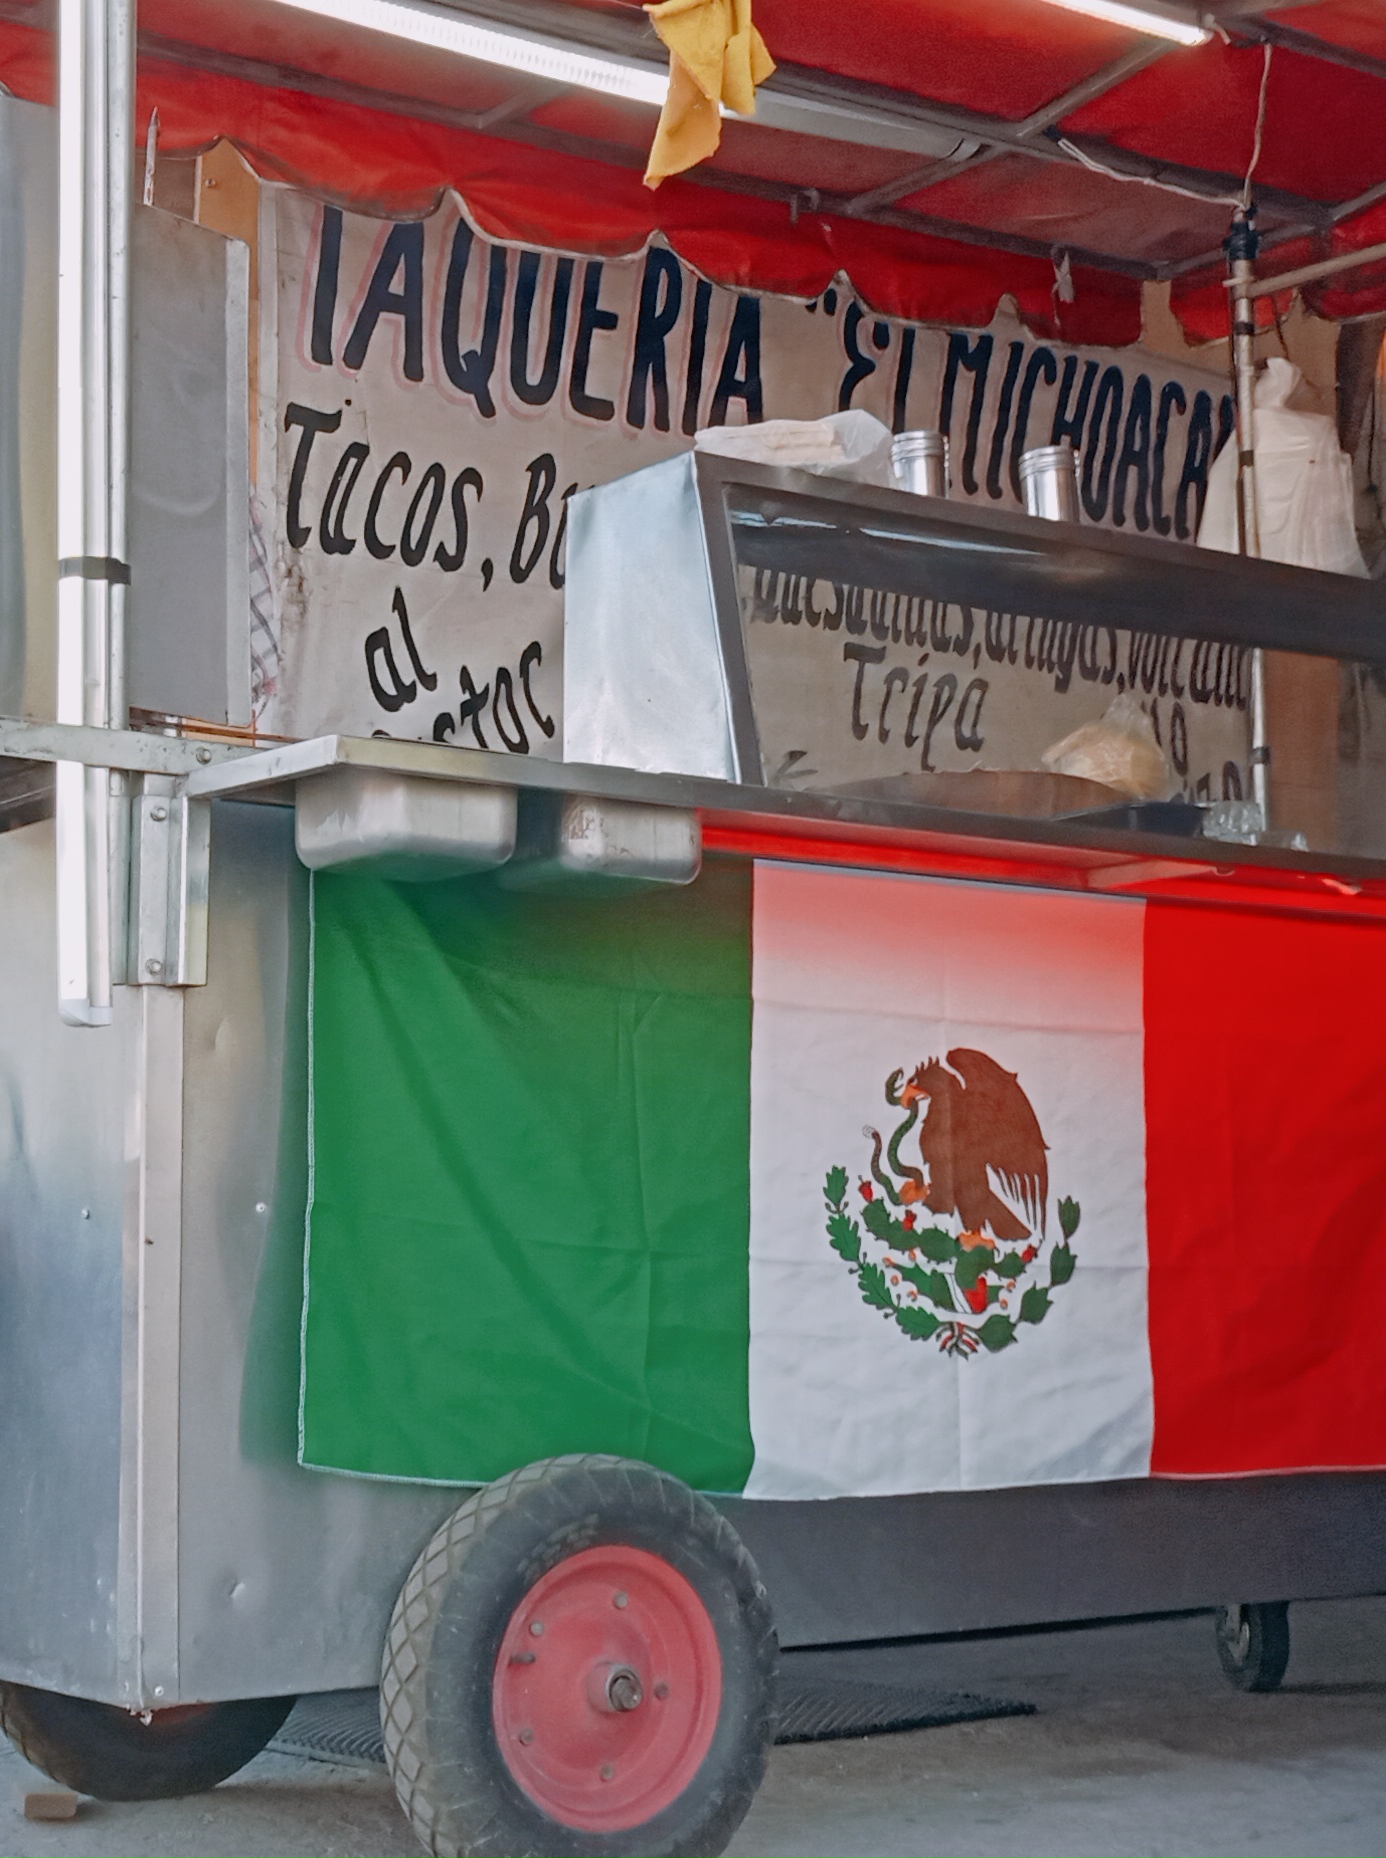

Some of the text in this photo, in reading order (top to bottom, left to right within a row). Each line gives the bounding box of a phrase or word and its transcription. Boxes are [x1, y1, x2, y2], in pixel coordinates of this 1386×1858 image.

[311, 205, 764, 437] TAQUERIA
[285, 402, 494, 592] Tacos,
[365, 586, 438, 713] al
[843, 641, 990, 773] Tripa
